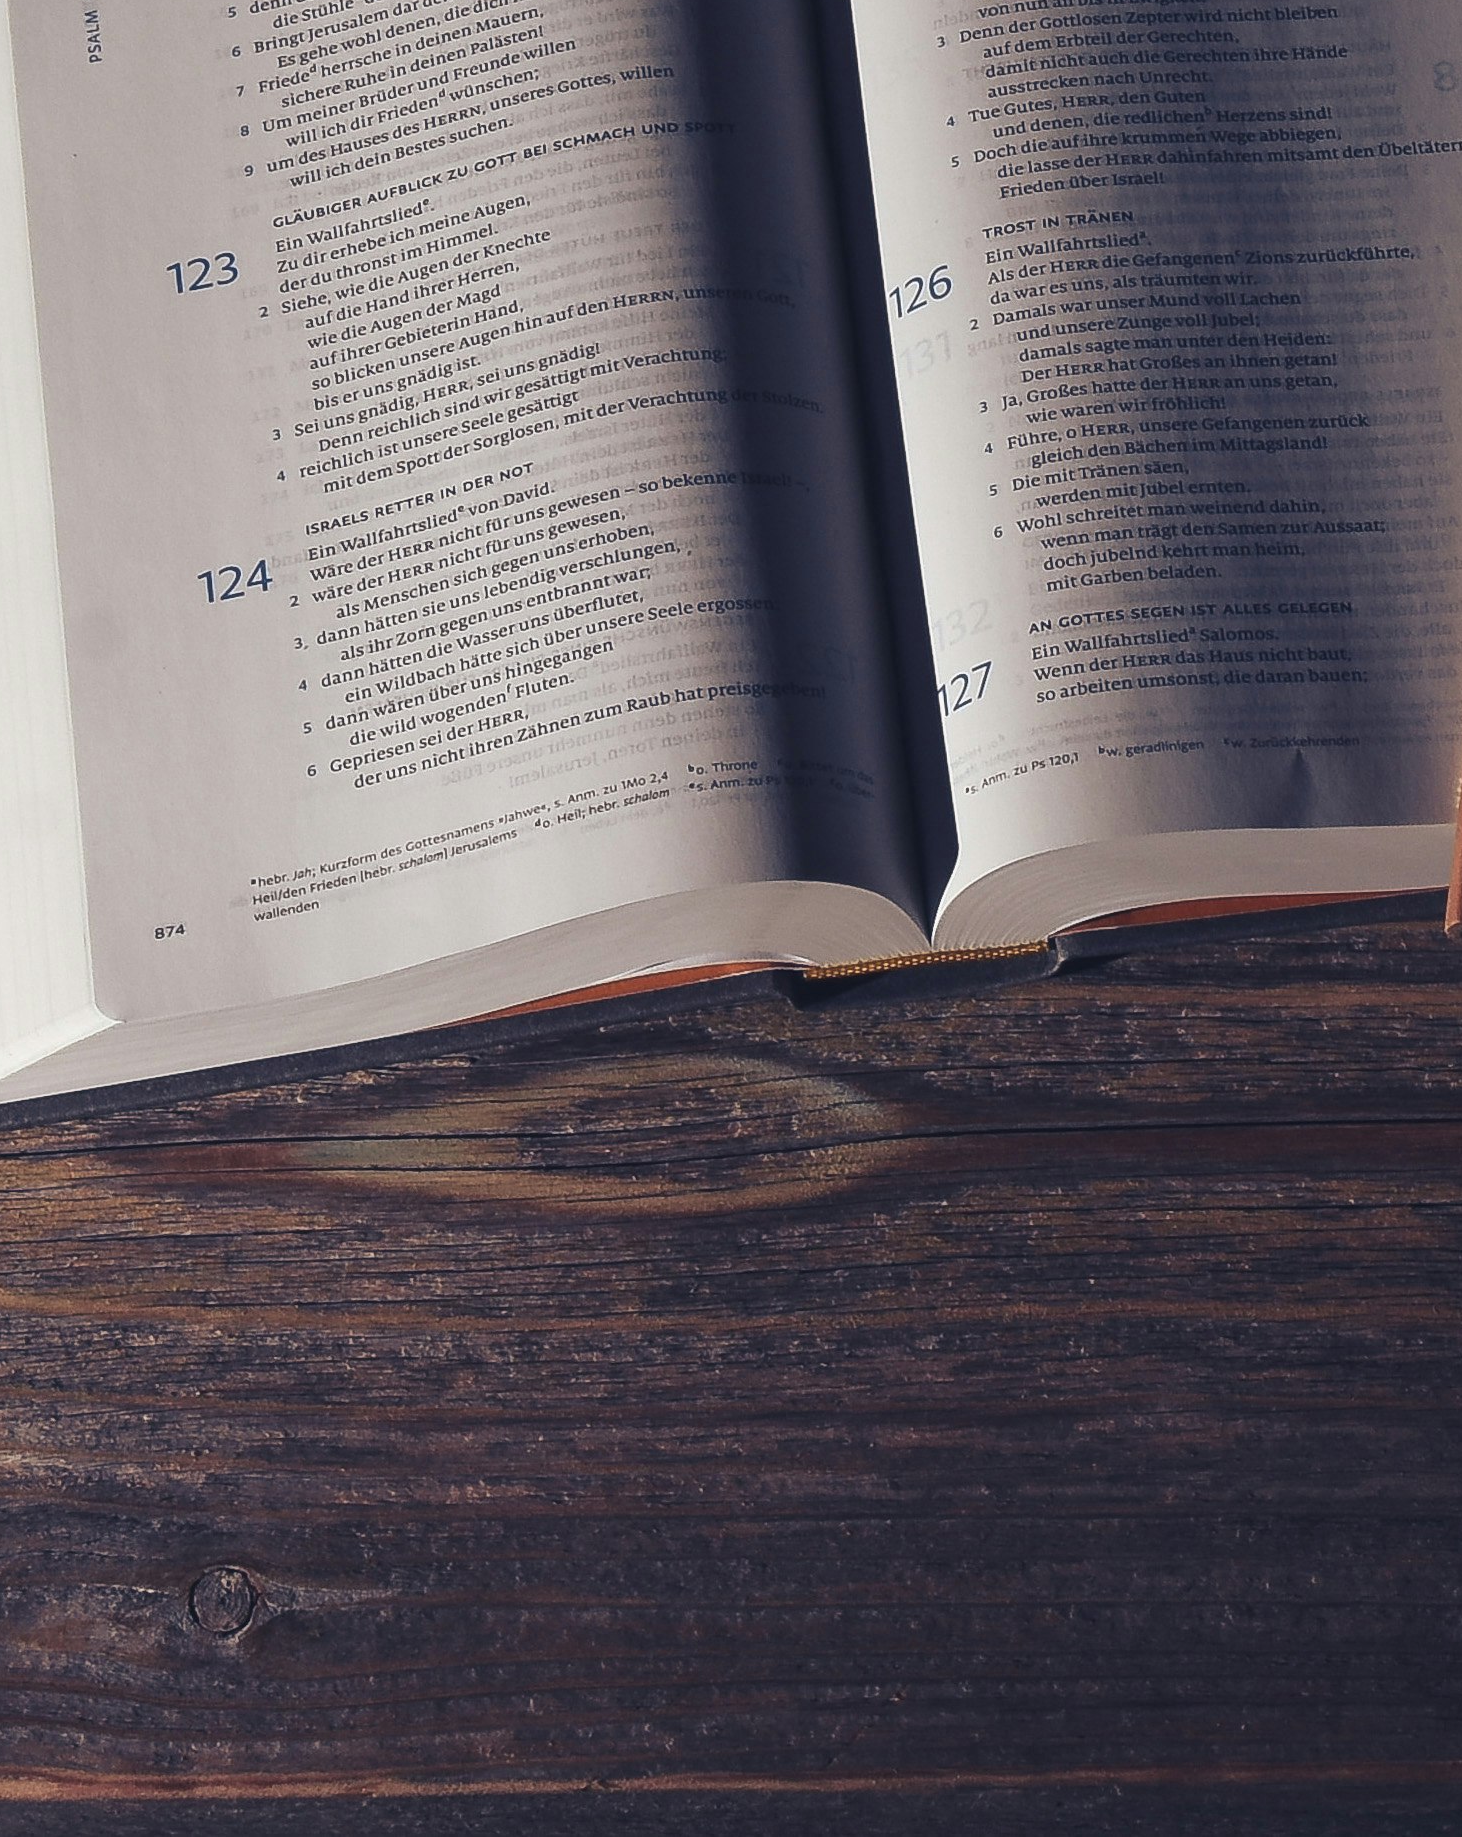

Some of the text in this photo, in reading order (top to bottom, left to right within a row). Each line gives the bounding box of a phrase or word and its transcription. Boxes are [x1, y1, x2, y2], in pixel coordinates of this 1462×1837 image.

[84, 9, 103, 64] PSALM
[276, 54, 298, 70] Es
[298, 43, 340, 67] gehe
[338, 27, 383, 52] wohl
[384, 15, 442, 40] denen,
[442, 4, 472, 23] die
[935, 5, 1340, 49] 3 Denn der Gottlosen Zepter wird nicht bleiben
[945, 89, 1207, 128] 4 Tue Gutes, HERR, den Guten
[271, 196, 363, 229] GLÄUBIGER
[365, 172, 444, 206] AUFBLICK
[445, 164, 470, 182] ZU
[473, 150, 519, 174] GOTT
[522, 142, 548, 160] BEI
[551, 125, 637, 153] SCHMACH
[640, 121, 681, 139] UND
[275, 195, 532, 275] Zu dir erhebe ich meine Augen,
[980, 207, 1135, 240] TROST IN TRÄNEN
[166, 252, 240, 294] 123
[257, 230, 552, 320] 2 Siehe, wie die Augen der Knechte
[889, 264, 952, 319] 126
[978, 374, 1339, 415] 3 Ja, Großes hatte der HERR an uns getan,
[304, 460, 535, 537] ISRAELS RETTER IN DER NOT
[988, 459, 1191, 498] 5 Die mit Tränen säen,
[197, 559, 275, 604] 124
[335, 524, 656, 620] als Menschen sich gegen uns erhoben,
[1028, 600, 1354, 636] AN GOTTES SEGEN IST ALLES GELEGEN
[302, 640, 615, 736] 5 dann wären über uns hingegangen
[938, 660, 992, 717] 127
[306, 708, 530, 778] 6 Gepriesen sei der HERR,
[251, 828, 519, 907] Heil/den Frieden [hebr. schalom] Jerusalems
[154, 923, 187, 941] 874
[252, 900, 321, 923] wallenden
